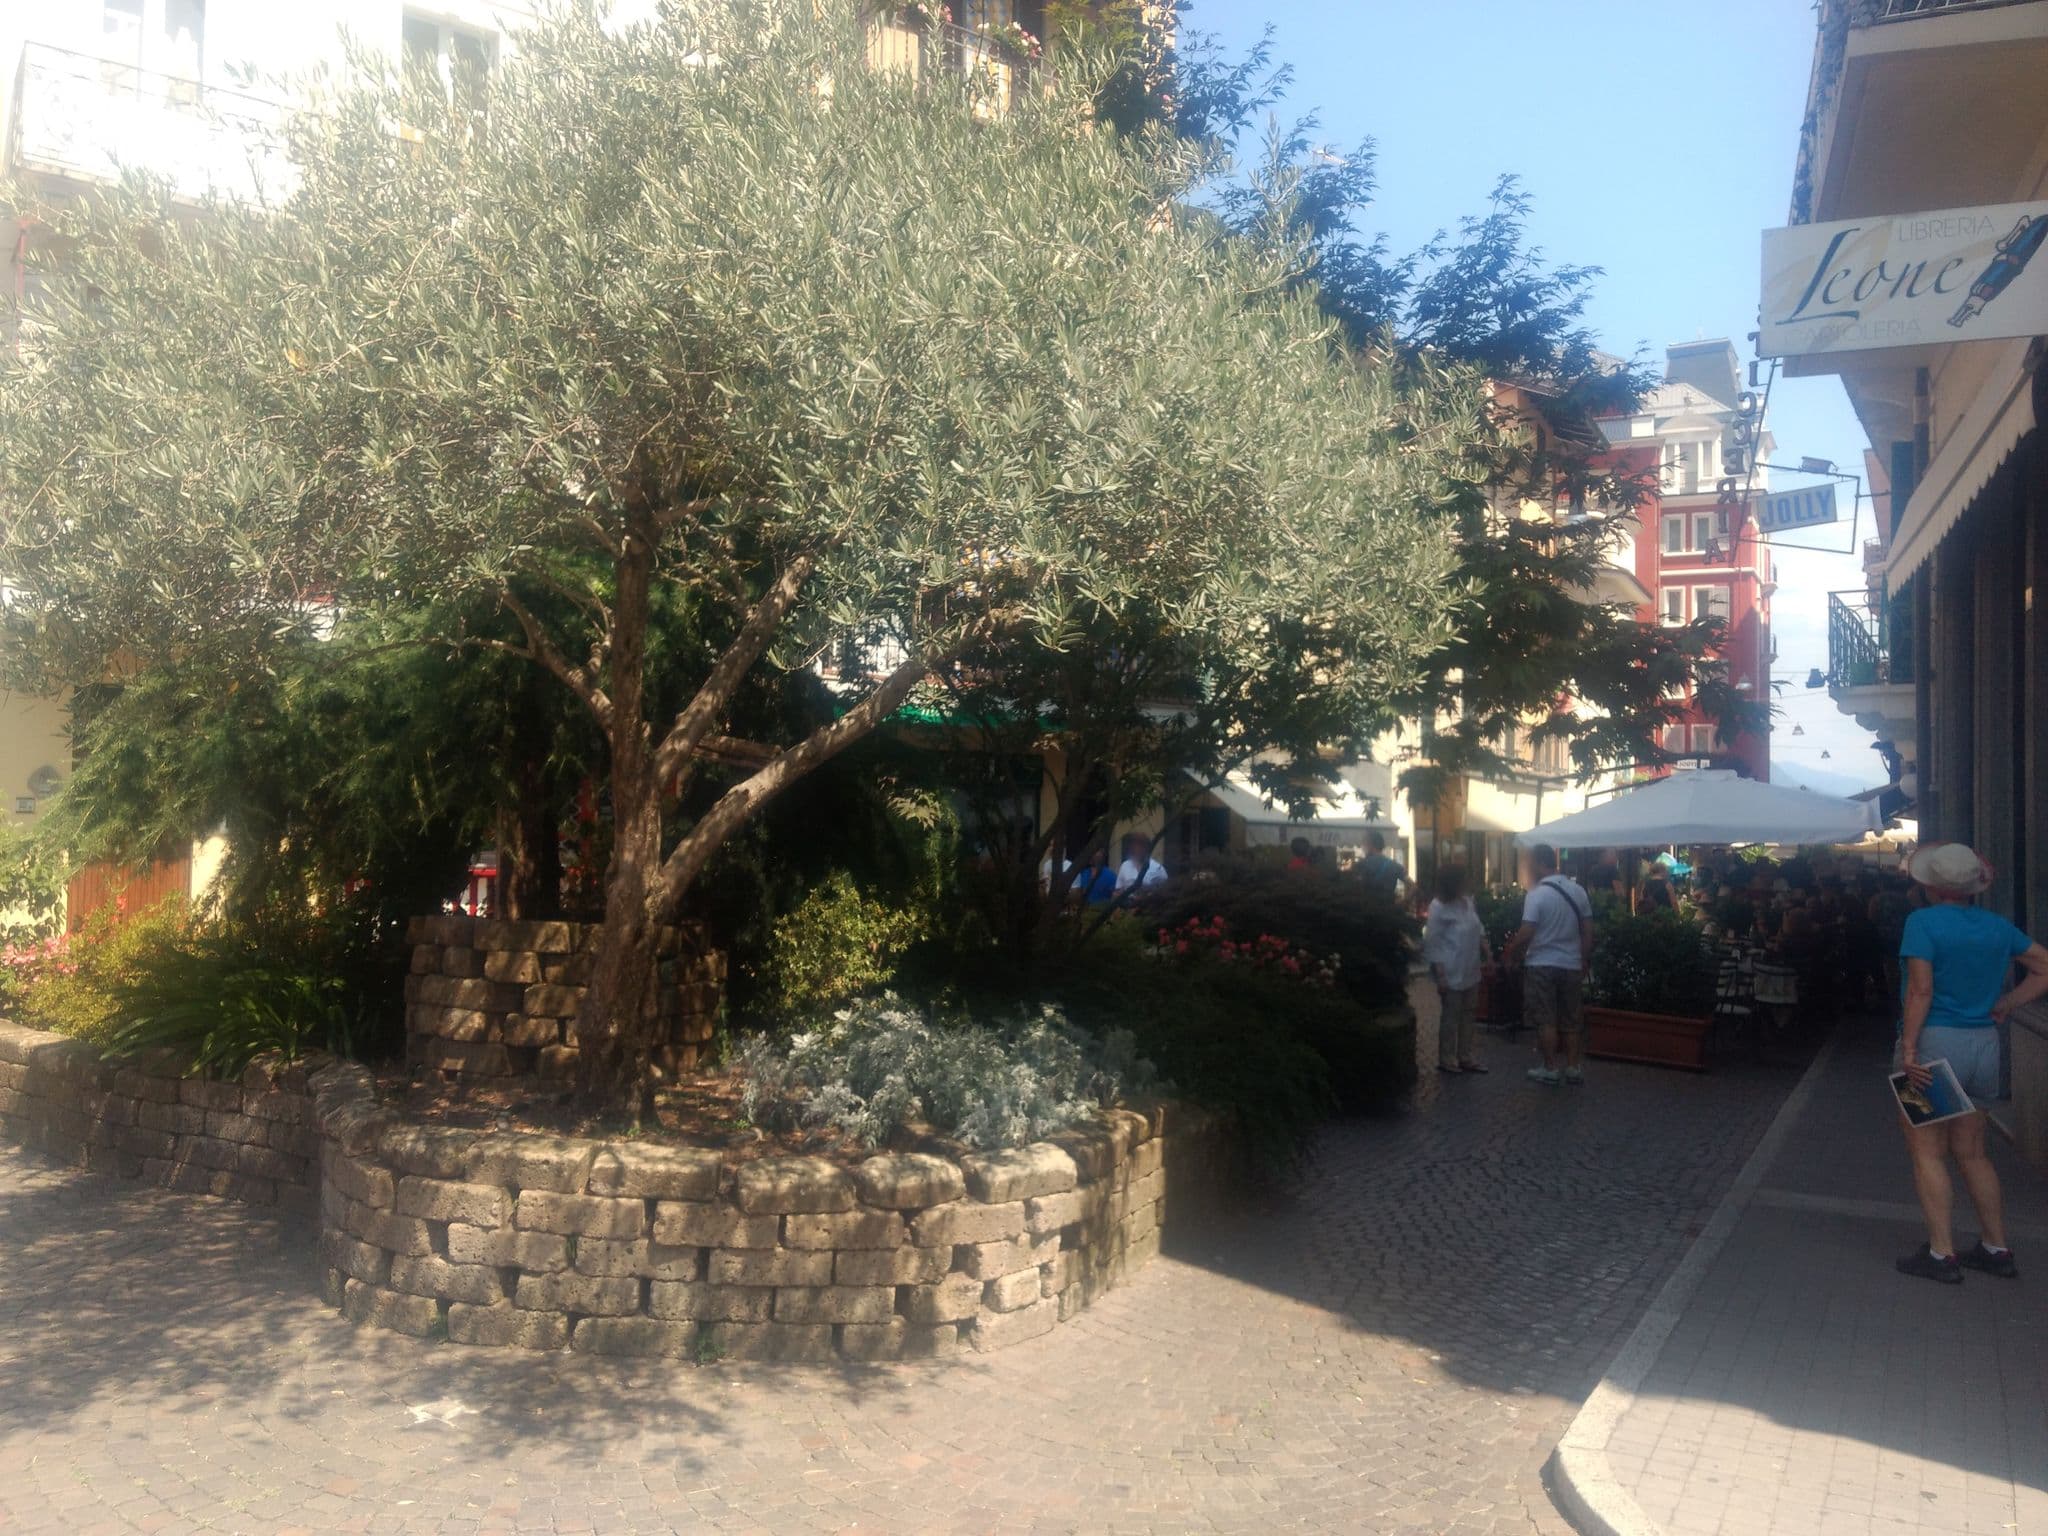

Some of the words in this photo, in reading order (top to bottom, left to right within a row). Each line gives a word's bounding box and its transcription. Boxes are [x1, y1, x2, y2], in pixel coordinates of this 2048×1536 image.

[1897, 215, 1994, 242] LIBRERIA
[1776, 227, 1964, 326] Leone
[1762, 489, 1832, 525] JOLLY
